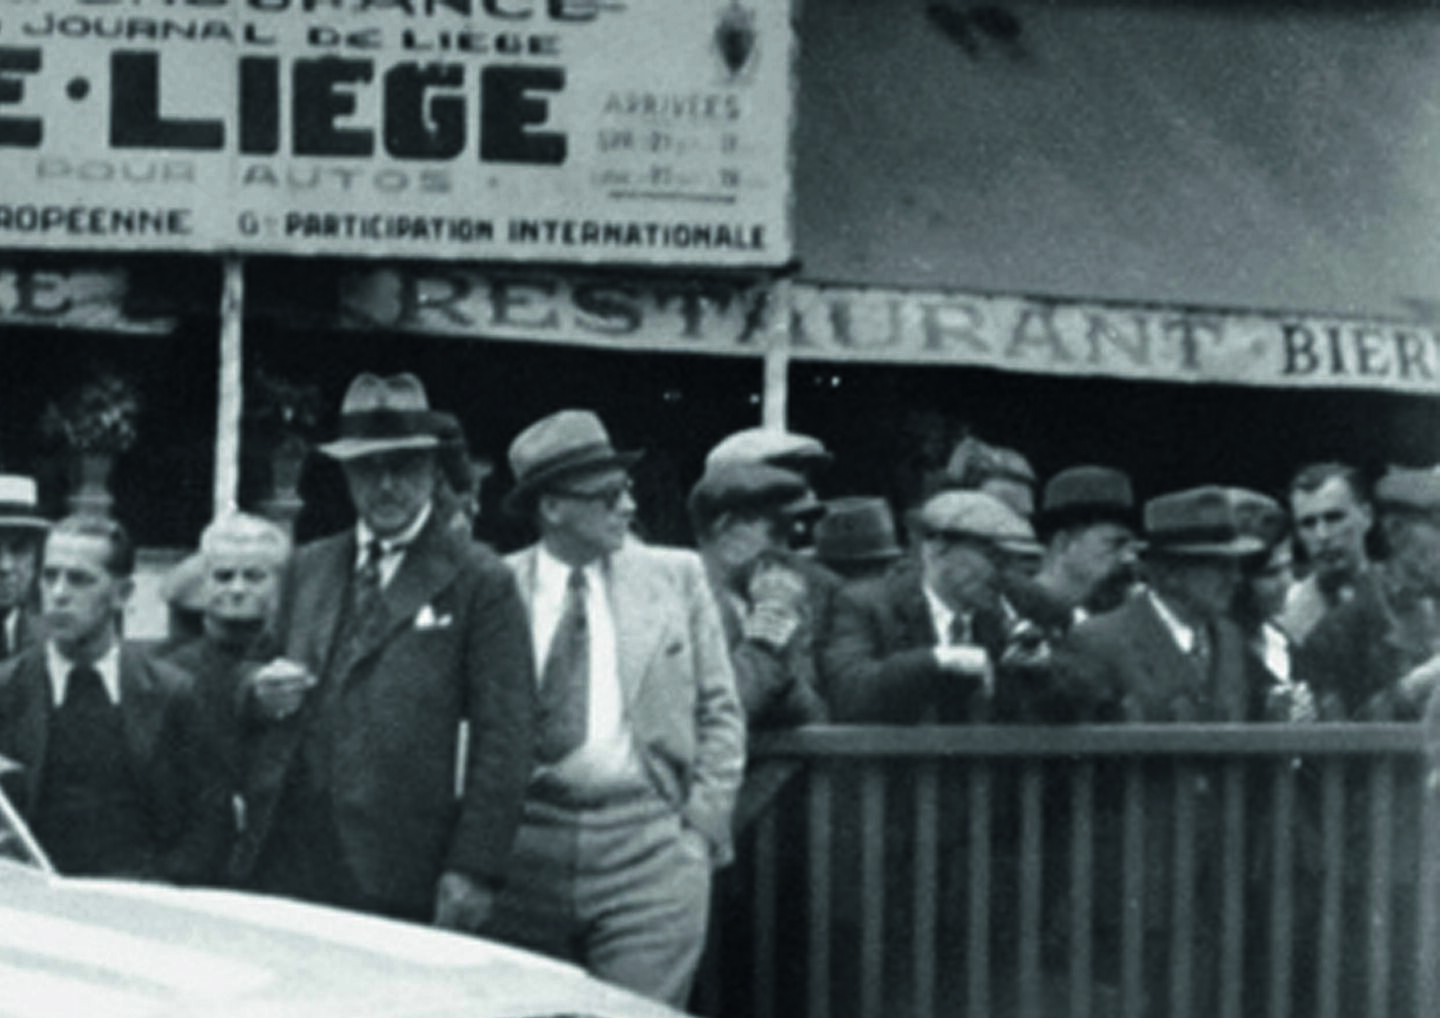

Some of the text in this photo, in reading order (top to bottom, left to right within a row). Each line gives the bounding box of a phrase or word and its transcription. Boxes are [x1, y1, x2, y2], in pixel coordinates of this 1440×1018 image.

[21, 12, 277, 45] JOURNAL
[34, 155, 197, 184] POUR
[242, 163, 453, 194] AUTOS
[284, 210, 495, 243] PARTICIPATION
[508, 219, 766, 250] INTERNATIONALE
[403, 270, 1227, 372] RESTAURANT
[1281, 321, 1440, 381] BIER
